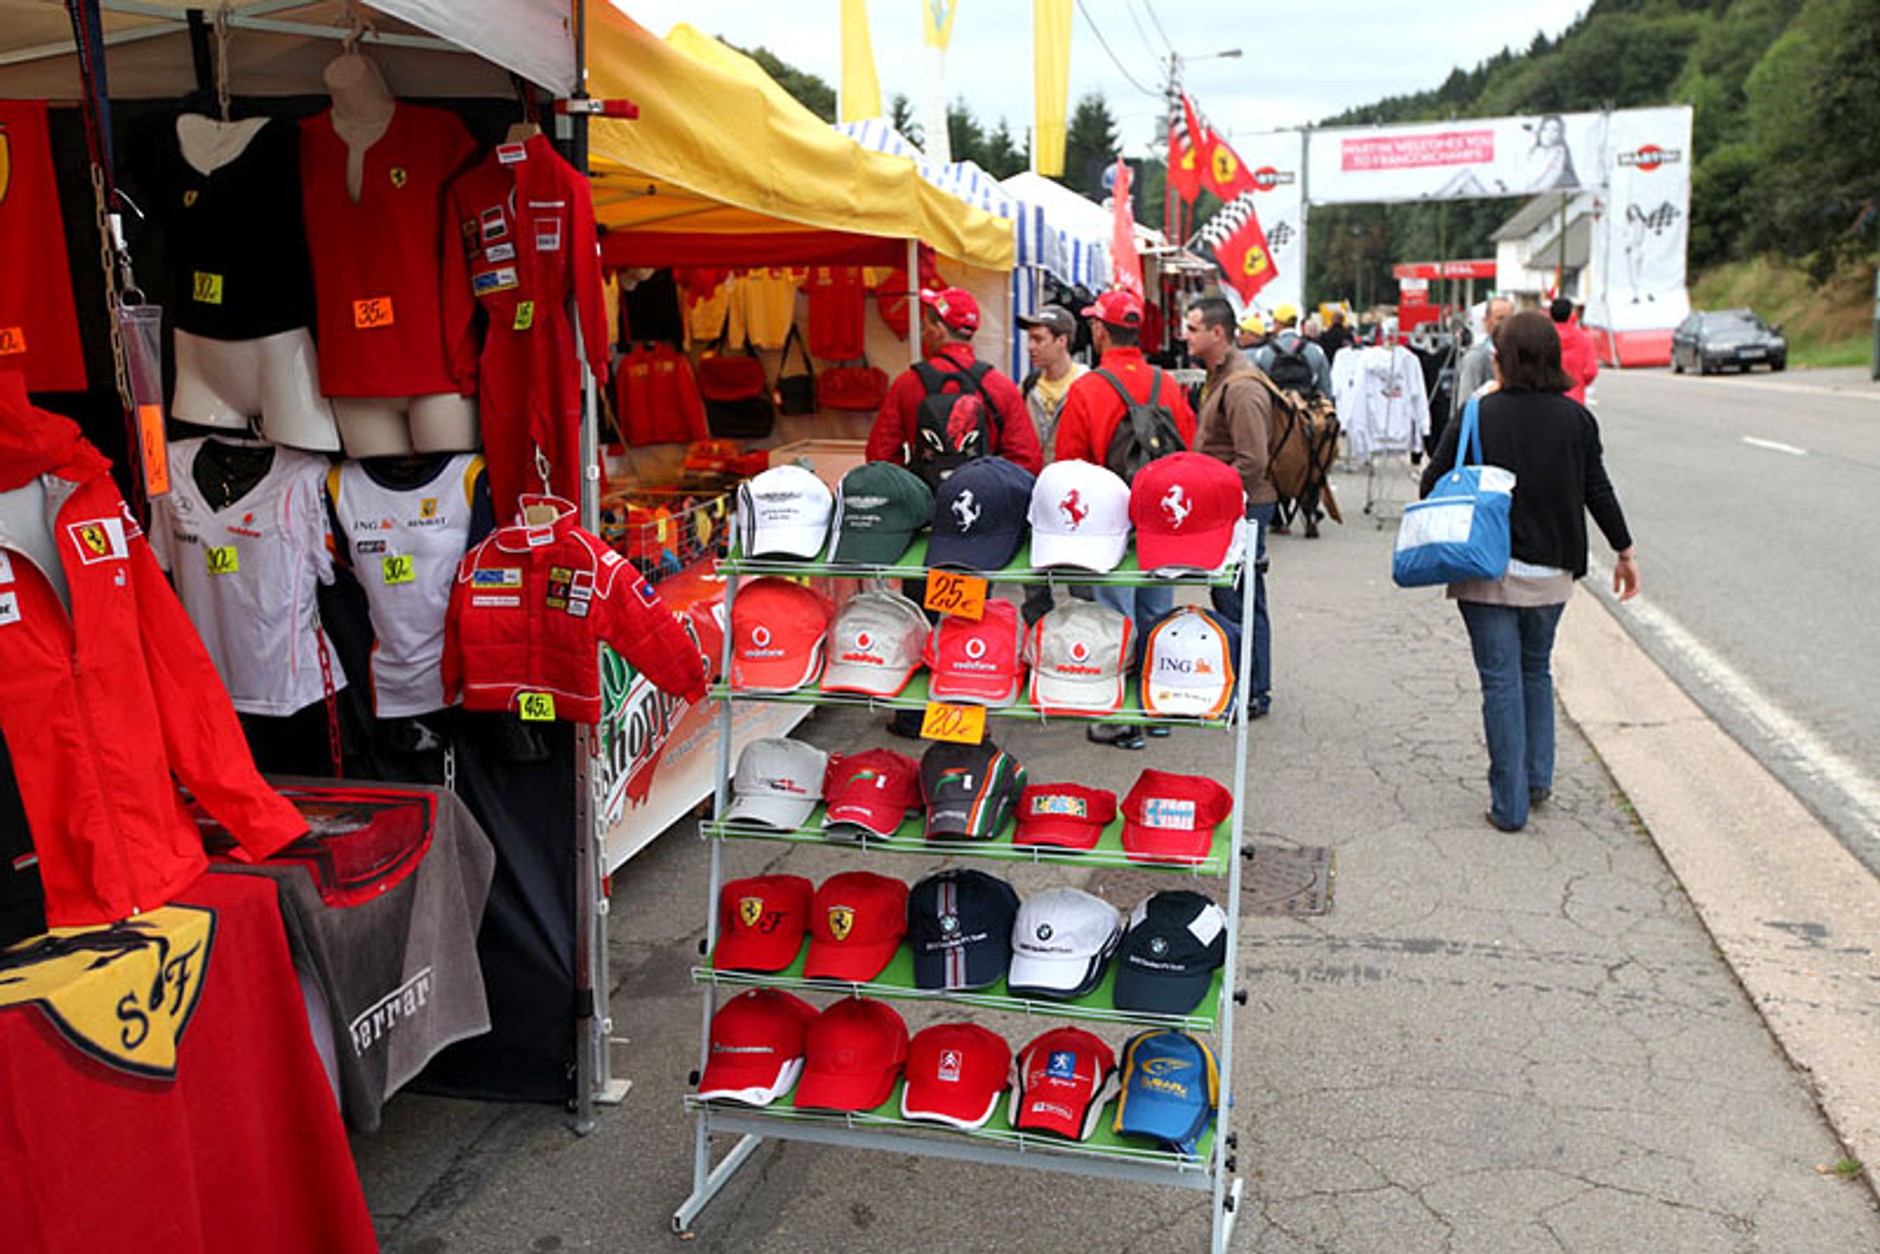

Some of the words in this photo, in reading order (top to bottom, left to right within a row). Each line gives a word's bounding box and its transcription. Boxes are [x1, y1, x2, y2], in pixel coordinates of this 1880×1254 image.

[1618, 150, 1681, 165] MARTINI
[352, 521, 377, 531] ING
[1159, 657, 1192, 674] ING
[164, 939, 201, 1016] F
[116, 989, 149, 1051] S
[350, 966, 435, 1057] Ferrar
